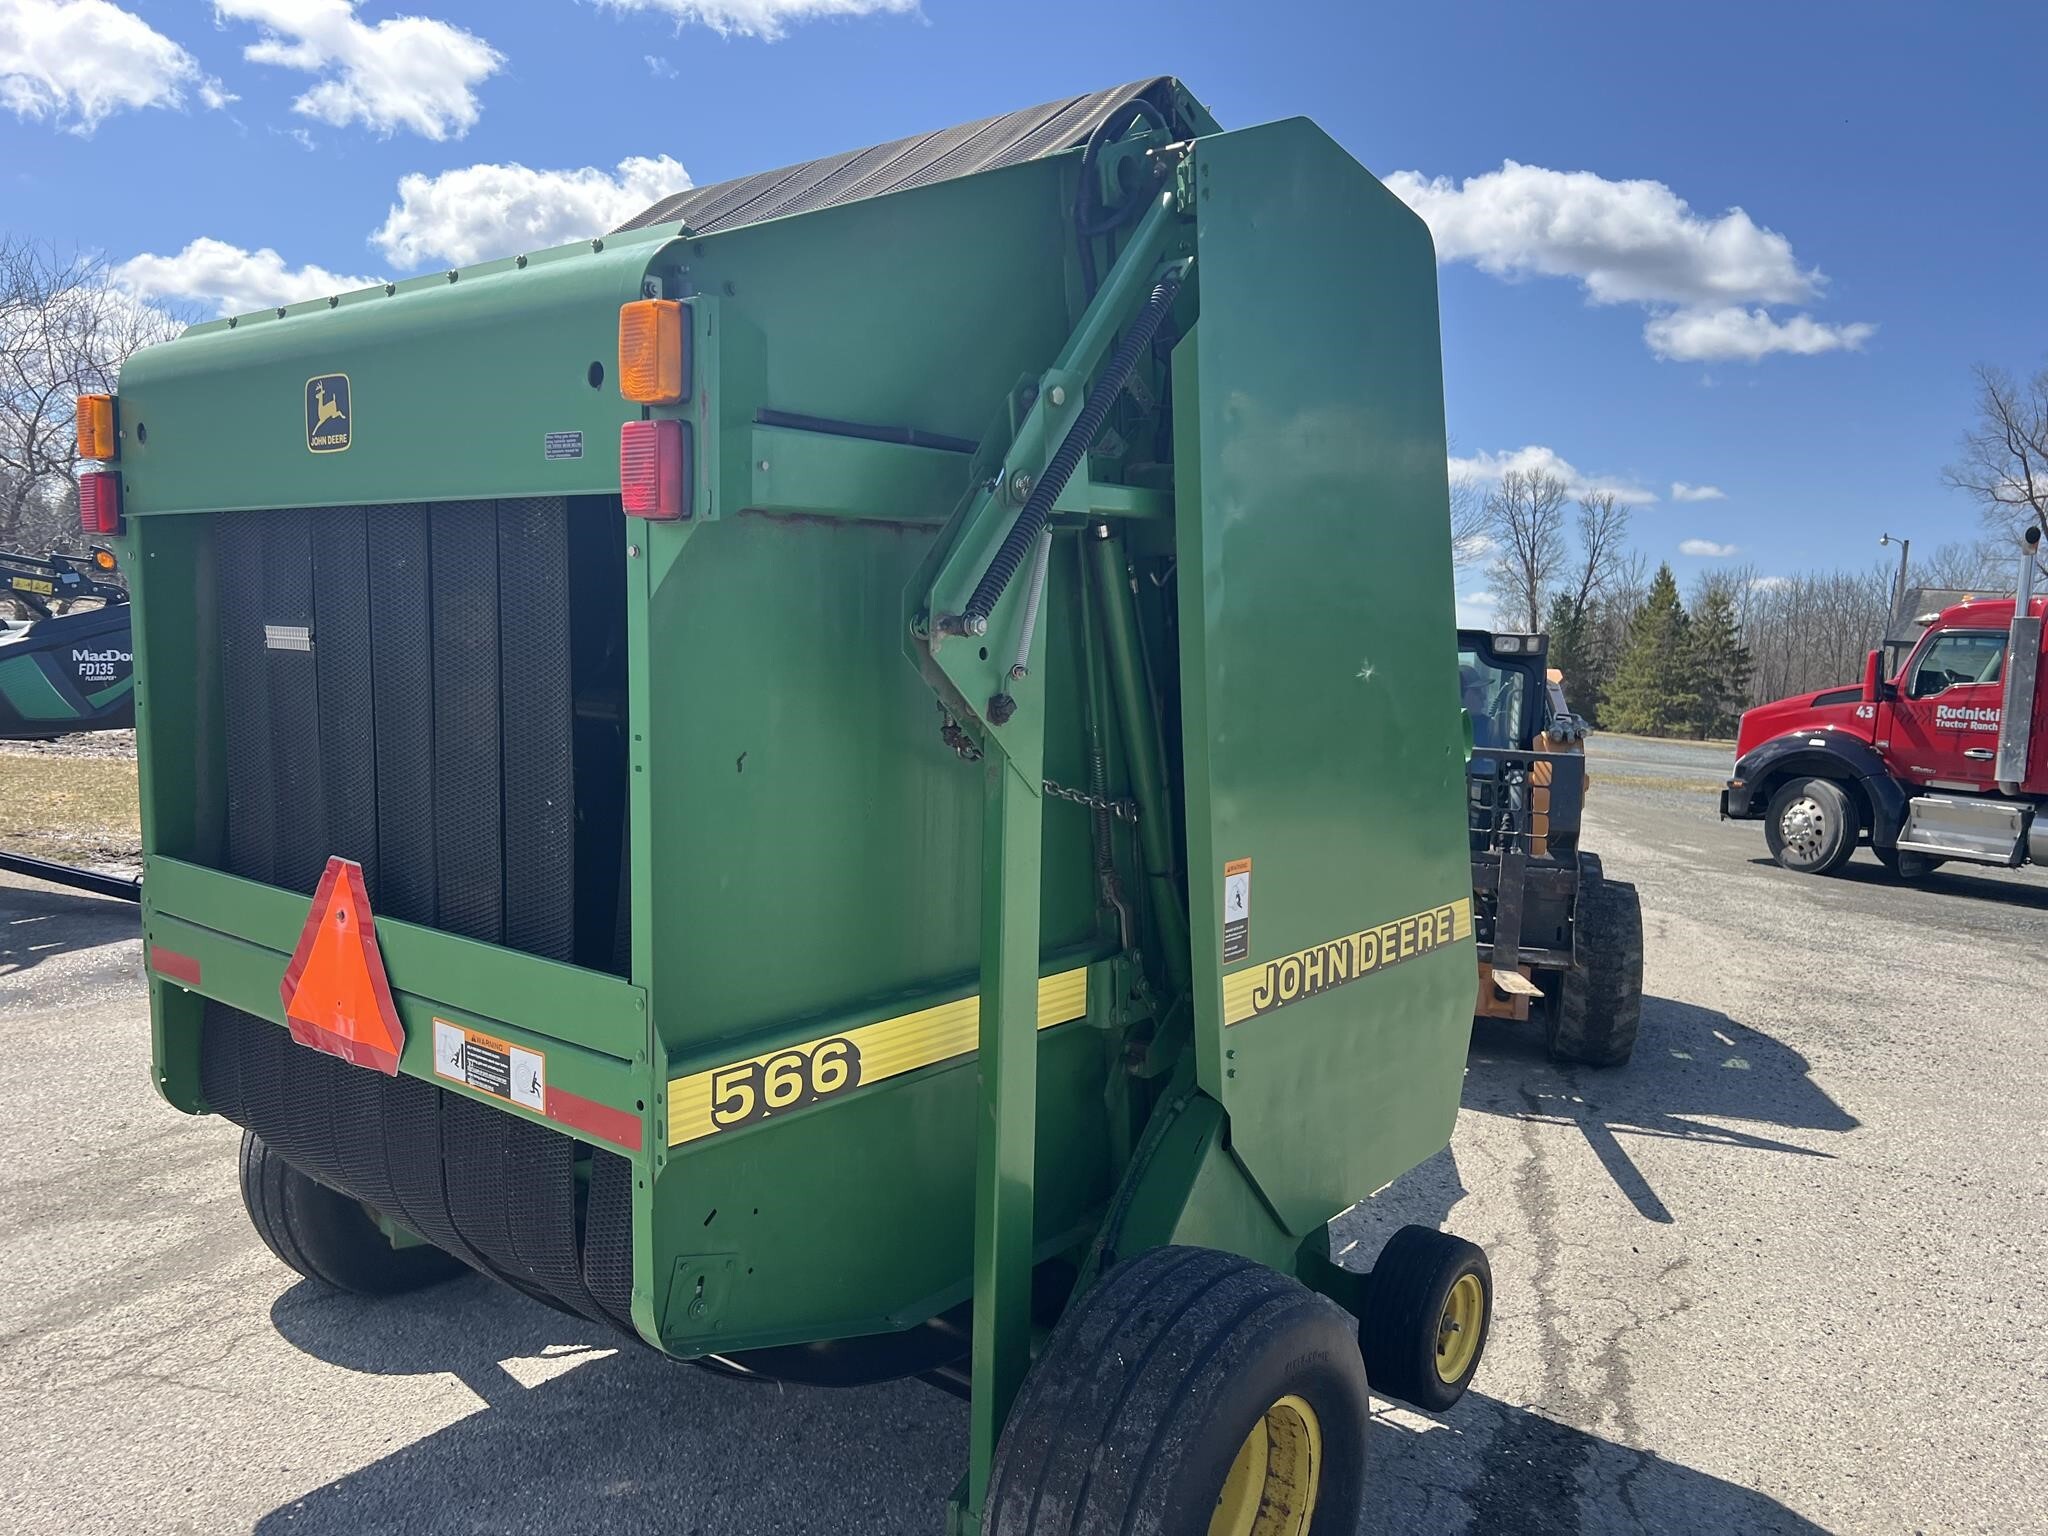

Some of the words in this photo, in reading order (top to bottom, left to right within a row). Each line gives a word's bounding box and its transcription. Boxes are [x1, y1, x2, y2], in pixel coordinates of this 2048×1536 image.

[311, 436, 327, 446] JOHN
[328, 434, 348, 445] DEERE
[79, 663, 114, 675] FD135
[1856, 706, 1874, 719] 43
[1937, 705, 2000, 721] Rudnicki
[1936, 719, 1968, 730] Tractor
[1970, 721, 1998, 731] Ranch
[1253, 939, 1350, 1012] JOHN
[1359, 907, 1452, 973] DEERE
[477, 1037, 503, 1052] WARNING
[712, 1039, 858, 1128] 566
